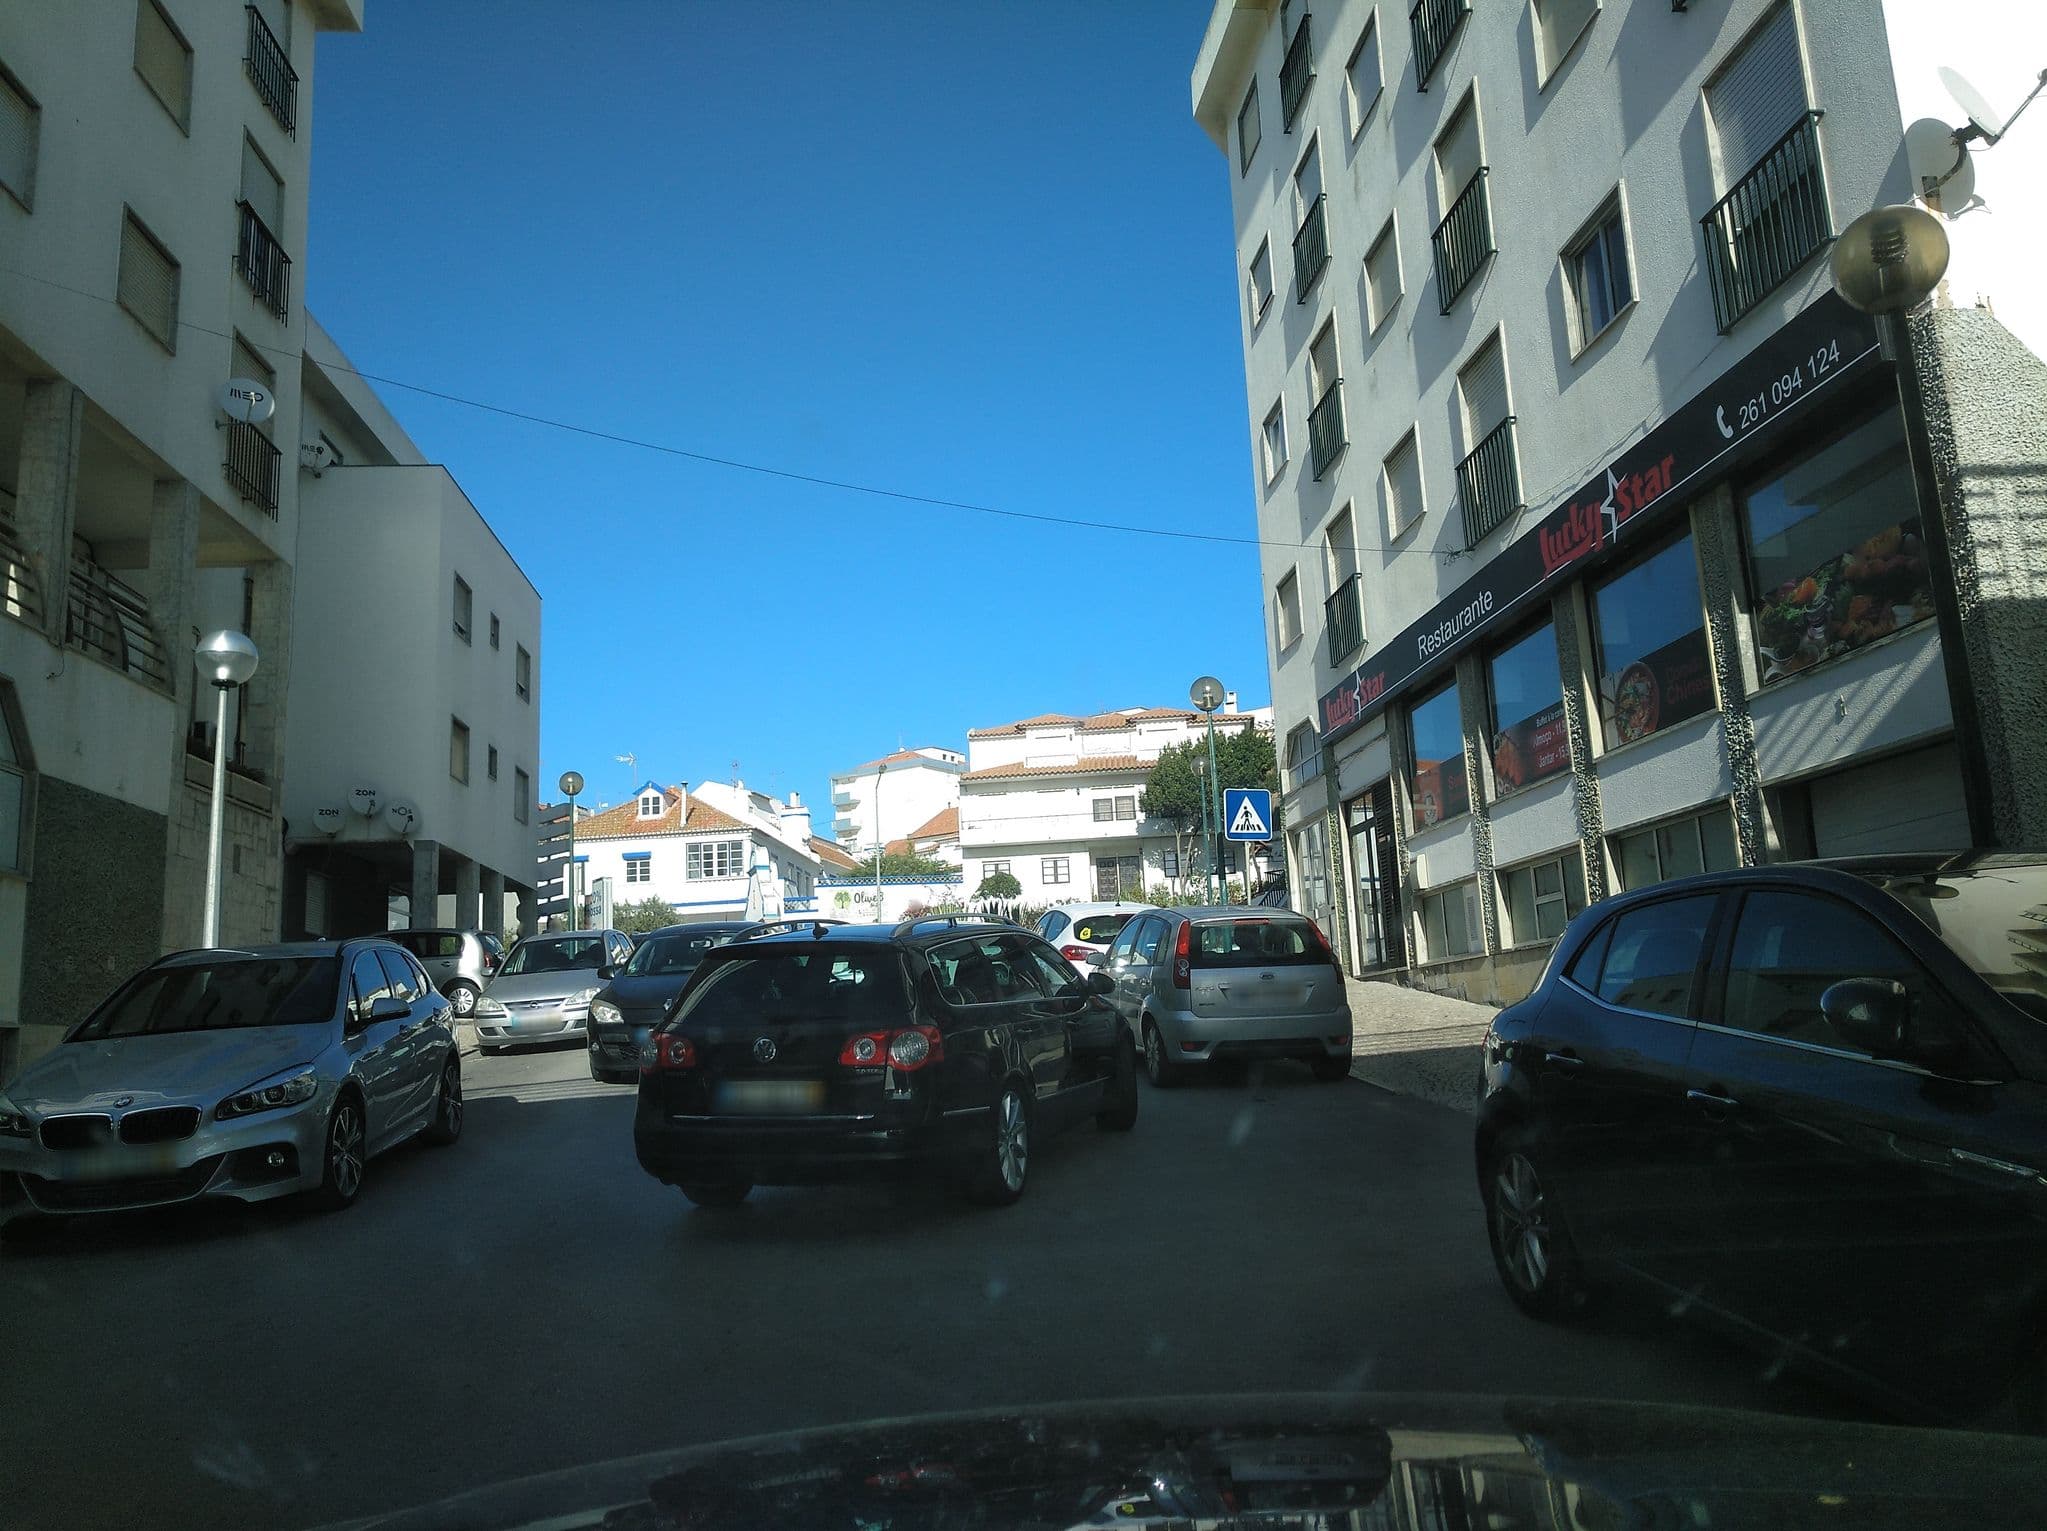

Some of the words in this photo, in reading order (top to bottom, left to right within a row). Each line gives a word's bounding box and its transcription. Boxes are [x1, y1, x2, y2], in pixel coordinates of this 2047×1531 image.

[1739, 391, 1767, 429] 261
[1771, 366, 1802, 405] 094
[1808, 338, 1840, 378] 124
[1539, 501, 1604, 580] Lucky
[1615, 453, 1674, 522] Star
[1417, 588, 1494, 660] Restaurante
[1325, 687, 1355, 730] Lucky
[1360, 671, 1385, 705] Star
[318, 808, 339, 816] ZON
